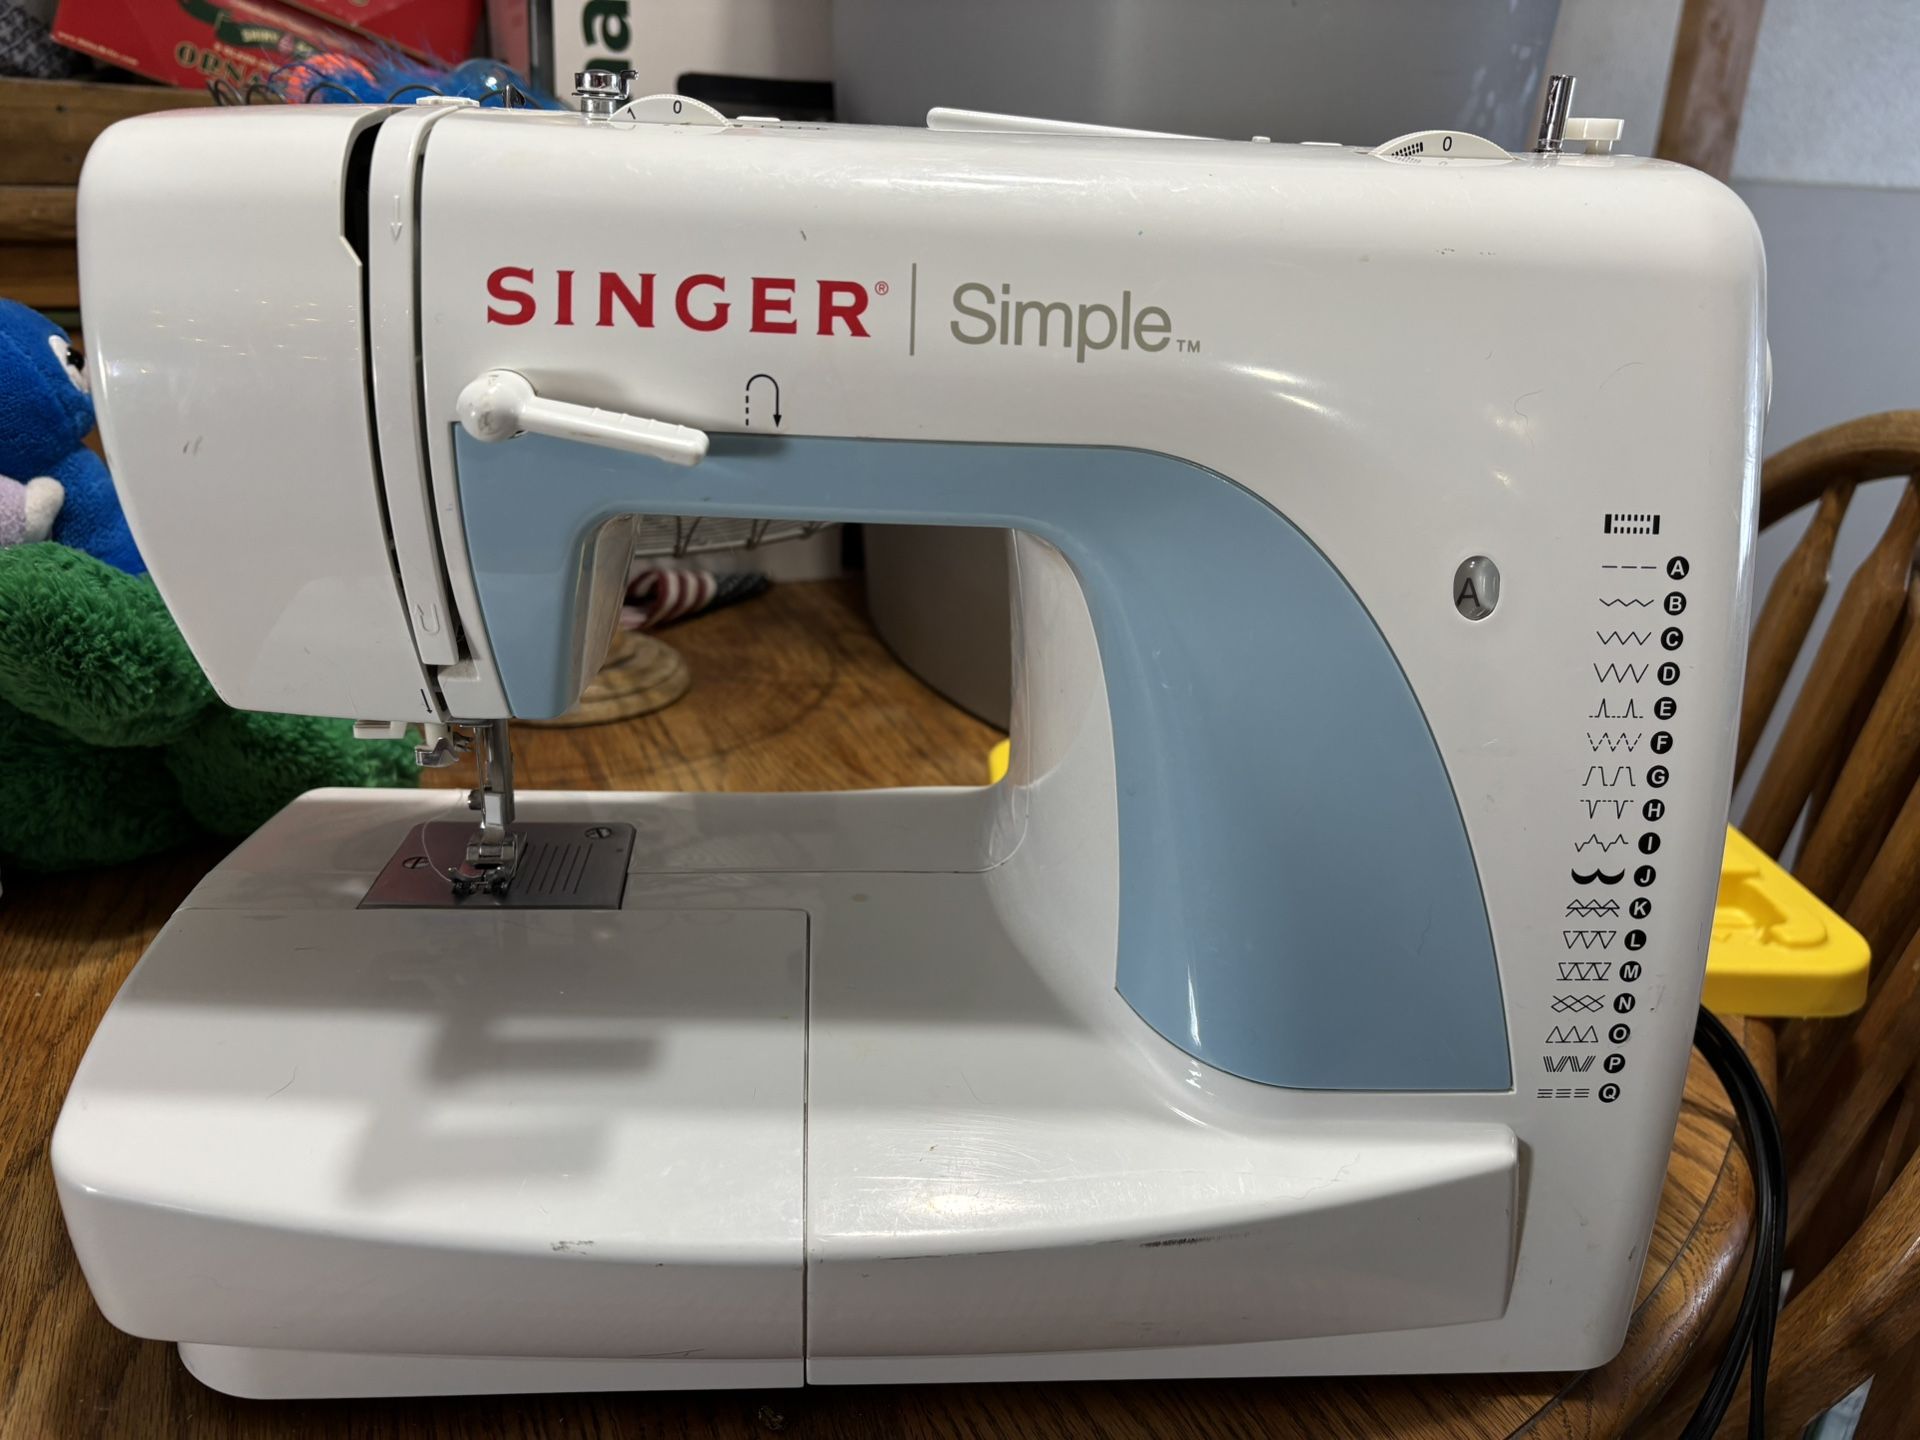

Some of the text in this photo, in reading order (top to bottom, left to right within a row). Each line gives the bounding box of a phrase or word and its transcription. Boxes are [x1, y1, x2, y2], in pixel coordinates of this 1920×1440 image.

[672, 99, 683, 115] 0
[1442, 135, 1453, 152] 0
[949, 281, 1172, 363] Simple
[1669, 558, 1686, 577] A
[1456, 577, 1481, 607] A
[1668, 594, 1683, 612] B
[1664, 630, 1680, 648] C
[1661, 664, 1677, 682] D
[1658, 699, 1674, 717] E
[1655, 734, 1670, 752] F
[1650, 768, 1666, 786] G
[1646, 801, 1662, 819] H
[1638, 867, 1652, 884] J
[1632, 900, 1648, 917] K
[1629, 932, 1642, 948] L
[1622, 963, 1640, 980] M
[1617, 995, 1633, 1011] N
[1612, 1025, 1628, 1042] O
[1607, 1055, 1622, 1072] P
[1601, 1084, 1618, 1101] Q
